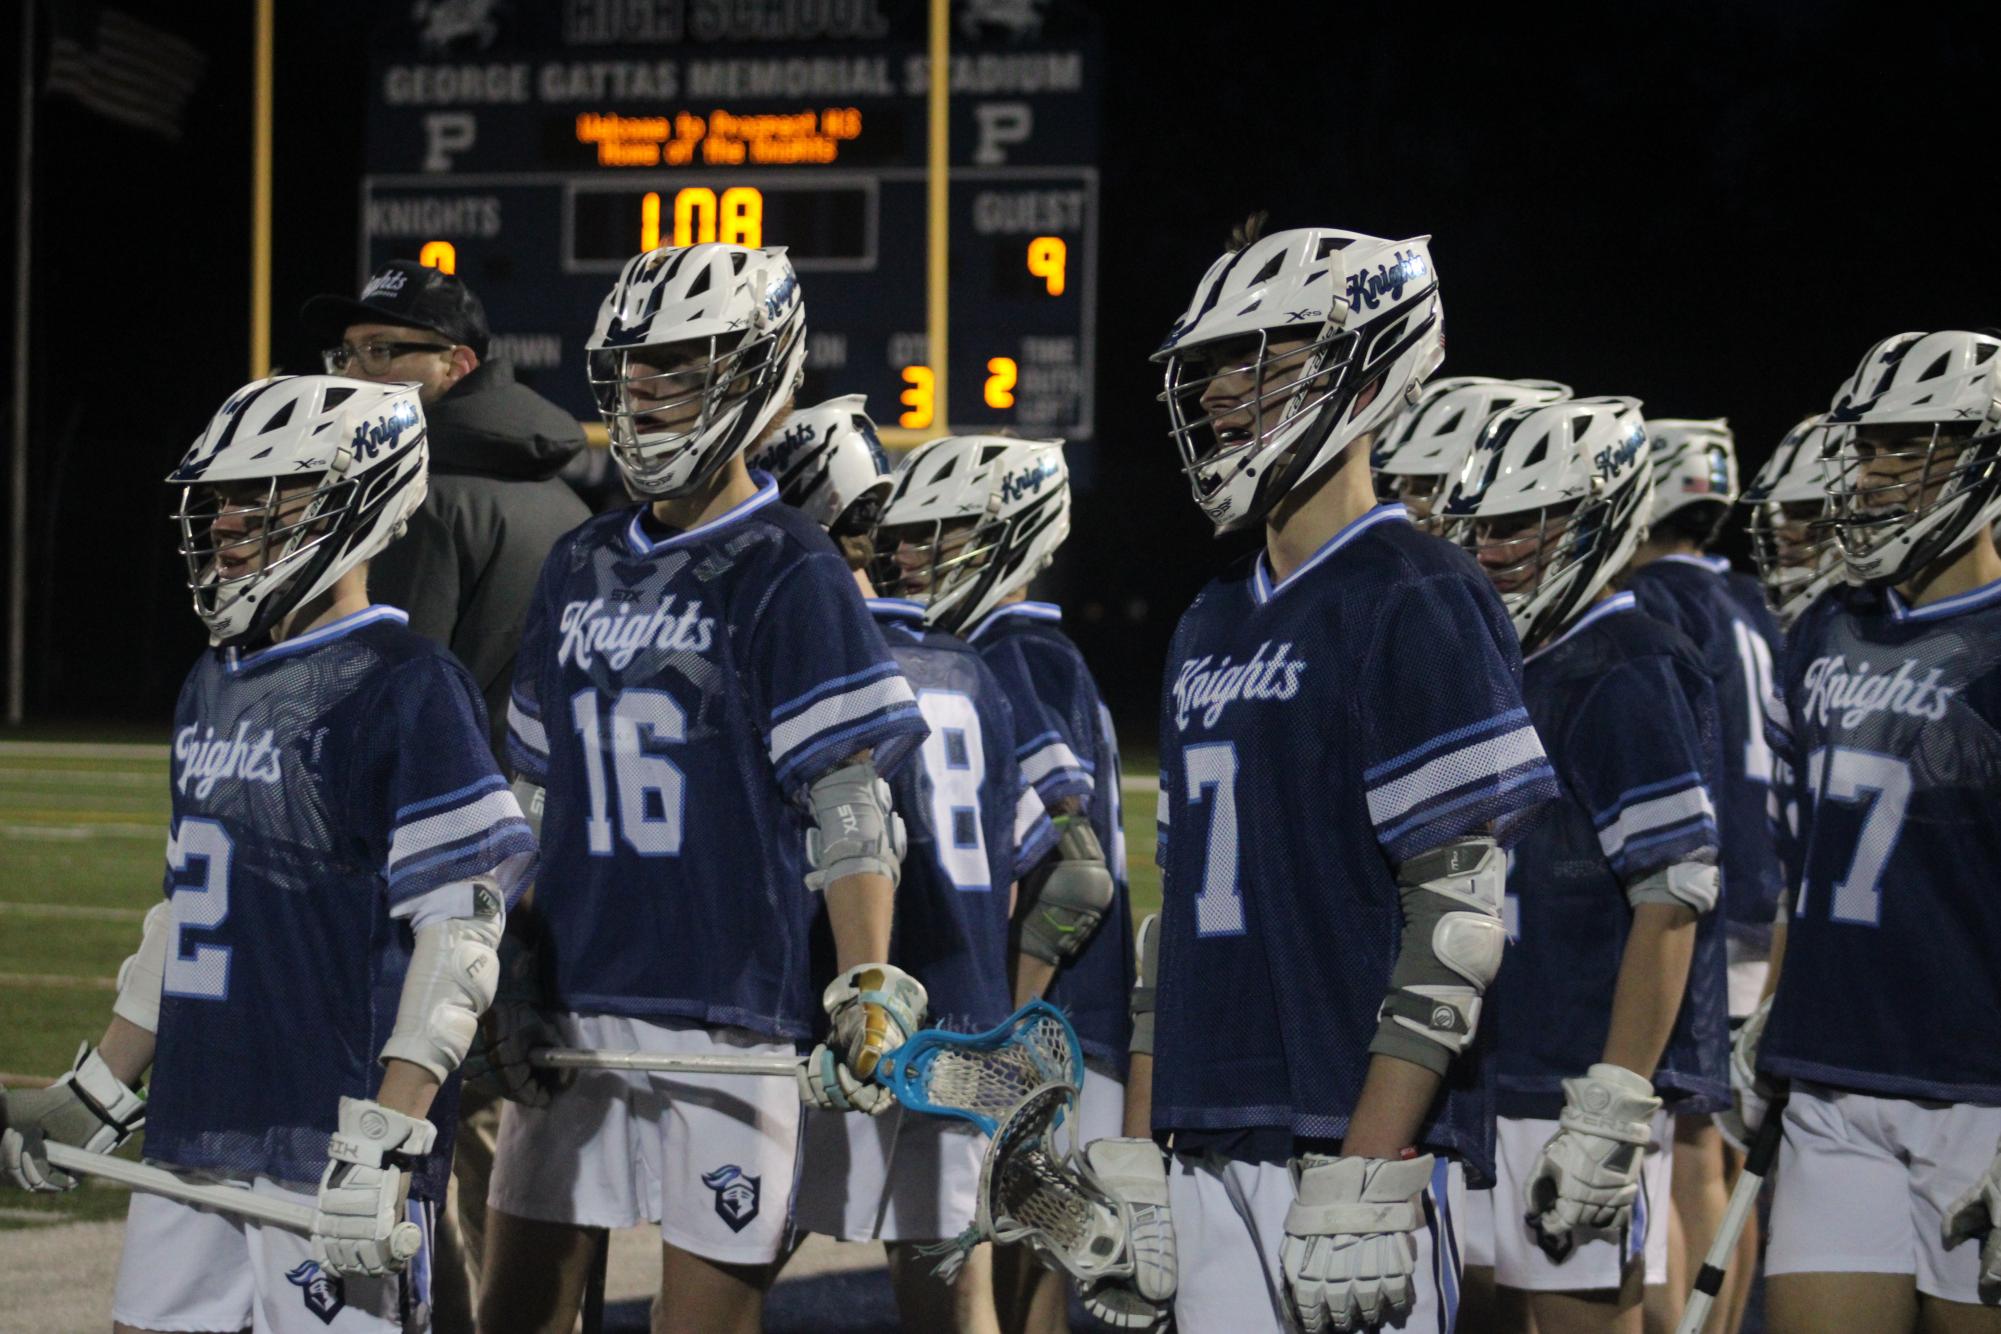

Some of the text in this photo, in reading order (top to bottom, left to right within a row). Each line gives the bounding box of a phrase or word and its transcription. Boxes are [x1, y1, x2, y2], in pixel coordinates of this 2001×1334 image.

[384, 53, 1084, 104] GEORGE GATTAS MEMORIAL SADIUM
[424, 112, 477, 171] P
[973, 103, 1033, 164] P
[367, 196, 501, 237] KNIGHTS
[973, 191, 1084, 234] GUEST
[1027, 236, 1067, 297] 9
[899, 365, 935, 430] 3
[983, 356, 1019, 409] 2
[558, 595, 716, 672] Knights
[1172, 639, 1307, 732] Knights
[1803, 654, 1956, 731] Knights
[572, 687, 688, 857] 16
[1182, 740, 1248, 938] 7
[164, 816, 236, 1002] 2
